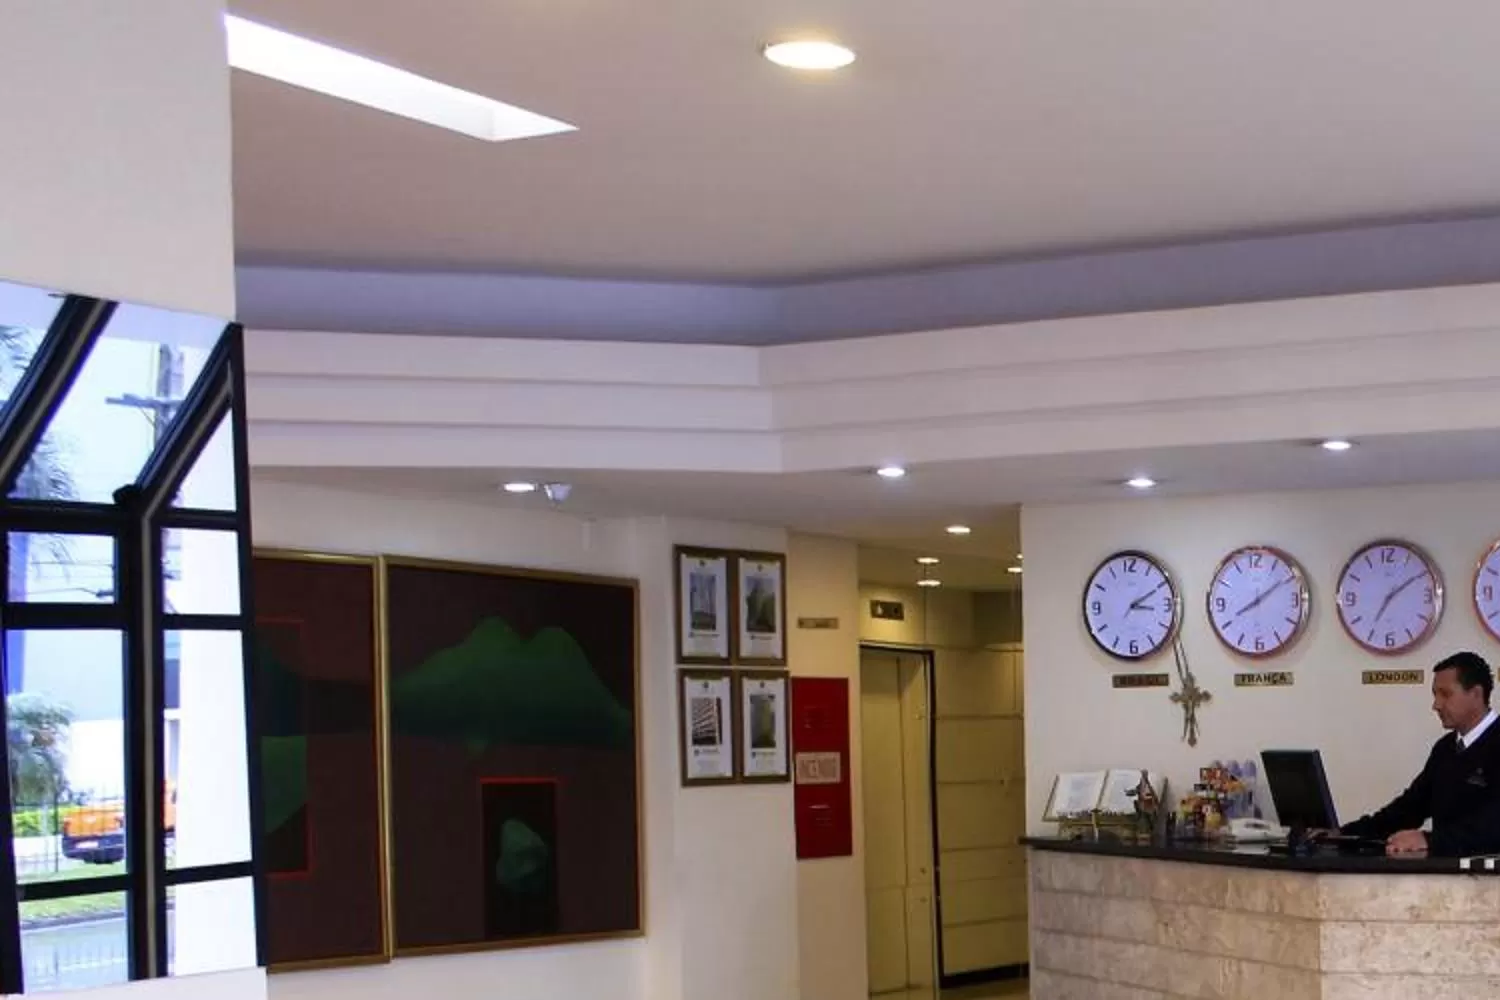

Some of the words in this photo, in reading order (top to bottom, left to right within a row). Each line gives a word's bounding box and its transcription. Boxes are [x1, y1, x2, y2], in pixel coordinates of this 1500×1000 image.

[1249, 554, 1262, 568] 12
[1381, 547, 1395, 564] 12
[1123, 558, 1137, 573] 12
[1163, 597, 1172, 613] 3
[1216, 597, 1226, 612] 9
[1345, 592, 1356, 607] 9
[1091, 601, 1102, 616] 9
[1129, 639, 1139, 654] 6
[1255, 637, 1265, 651] 6
[1385, 632, 1395, 647] 6
[1240, 673, 1287, 685] FRANÇA
[1368, 671, 1419, 681] LONDON
